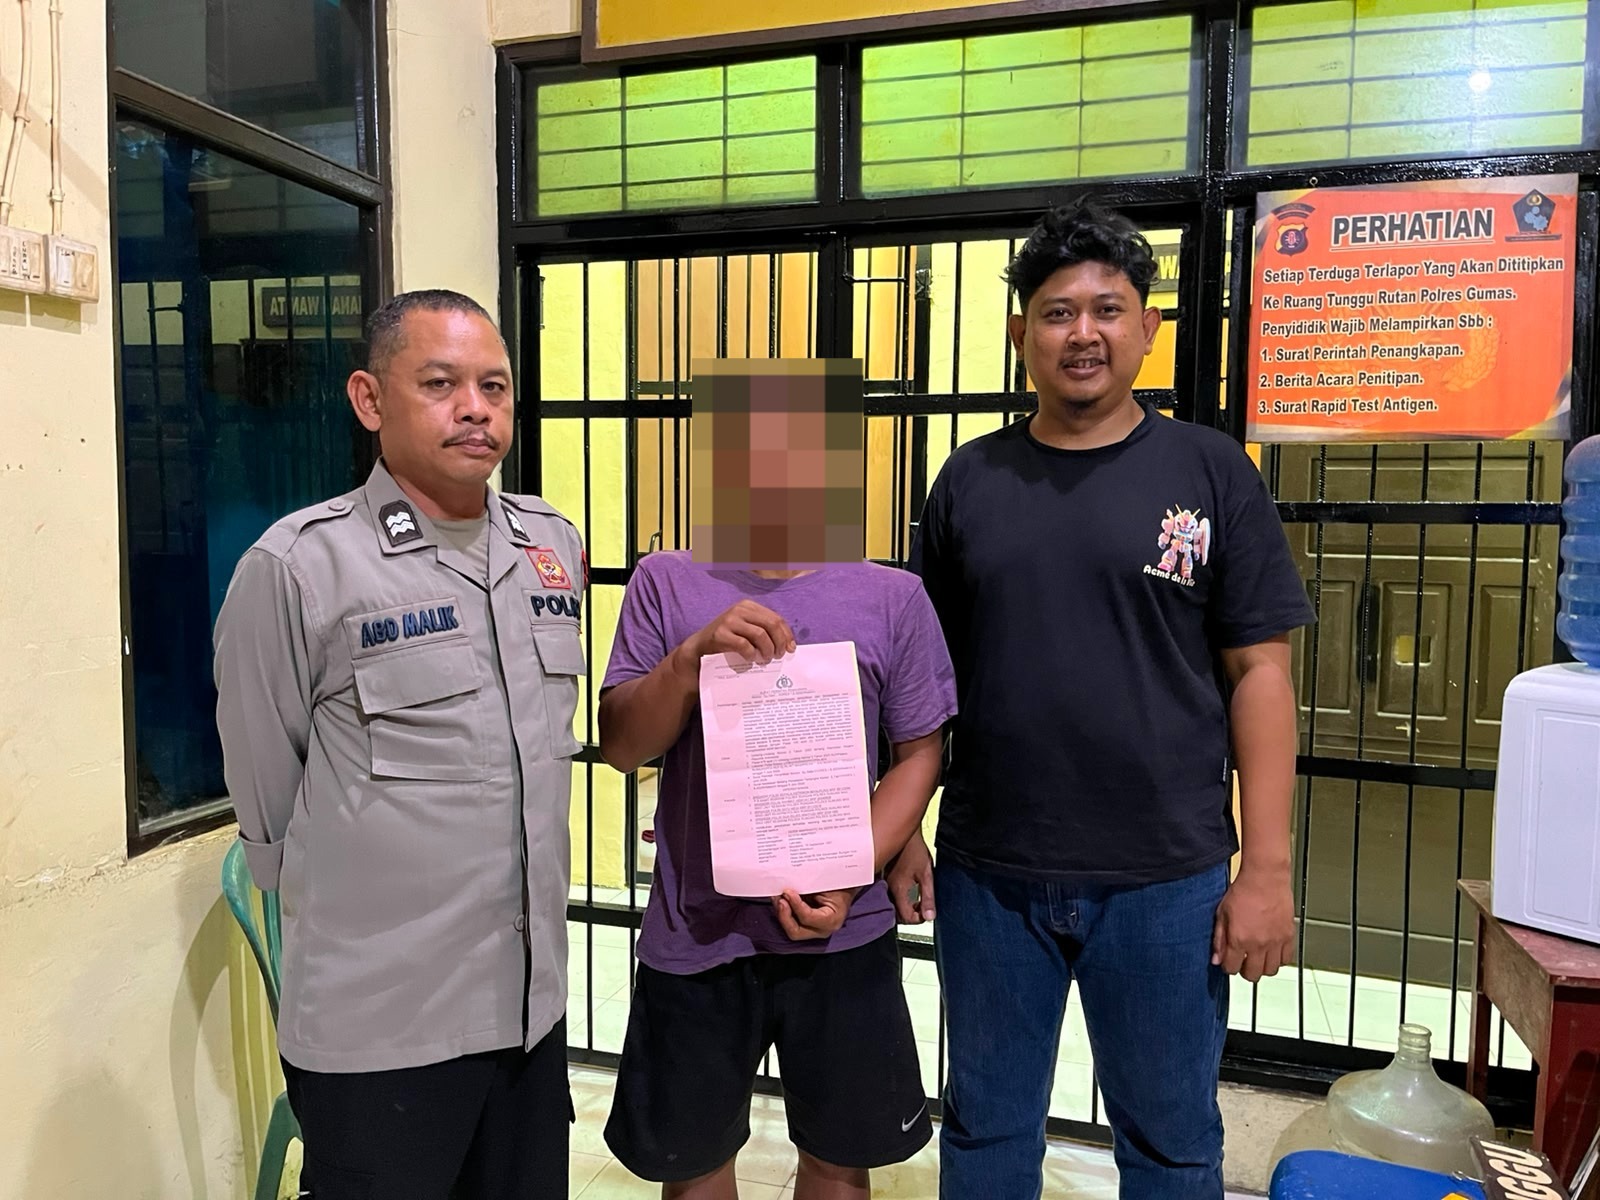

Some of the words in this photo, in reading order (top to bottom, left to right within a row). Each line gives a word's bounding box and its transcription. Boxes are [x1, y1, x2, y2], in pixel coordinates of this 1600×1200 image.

[1333, 209, 1493, 245] PERHATIAN
[1264, 268, 1304, 284] Setiap
[1308, 266, 1360, 281] Terduga
[1364, 264, 1419, 279] Terlapor
[1423, 261, 1455, 277] Yang
[1459, 259, 1493, 273] Akan
[1498, 257, 1563, 274] Dititipkan
[1263, 296, 1280, 309] Ke
[1284, 295, 1323, 310] Ruang
[1327, 293, 1374, 308] Tunggu
[1378, 291, 1416, 304] Rutan
[1420, 288, 1462, 302] Polres
[1466, 286, 1517, 300] Gumas.
[1262, 321, 1326, 338] Penyididik
[1330, 319, 1365, 335] Wajib
[1369, 316, 1454, 332] Melampirkan
[1459, 314, 1484, 328] Sbb
[1261, 348, 1272, 361] 1.
[1276, 348, 1309, 361] Surat
[1313, 345, 1366, 360] Perintah
[1371, 344, 1464, 360] Penangkapan.
[1260, 375, 1271, 387] 2.
[1275, 373, 1312, 387] Berita
[1316, 373, 1354, 386] Acara
[1358, 371, 1423, 387] Penitipan.
[1259, 400, 1270, 413] 3.
[1274, 400, 1307, 413] Surat
[1311, 399, 1347, 414] Rapid
[1351, 399, 1379, 411] Test
[1383, 398, 1438, 413] Antigen.
[361, 617, 400, 648] ABD
[402, 605, 459, 638] MALIK
